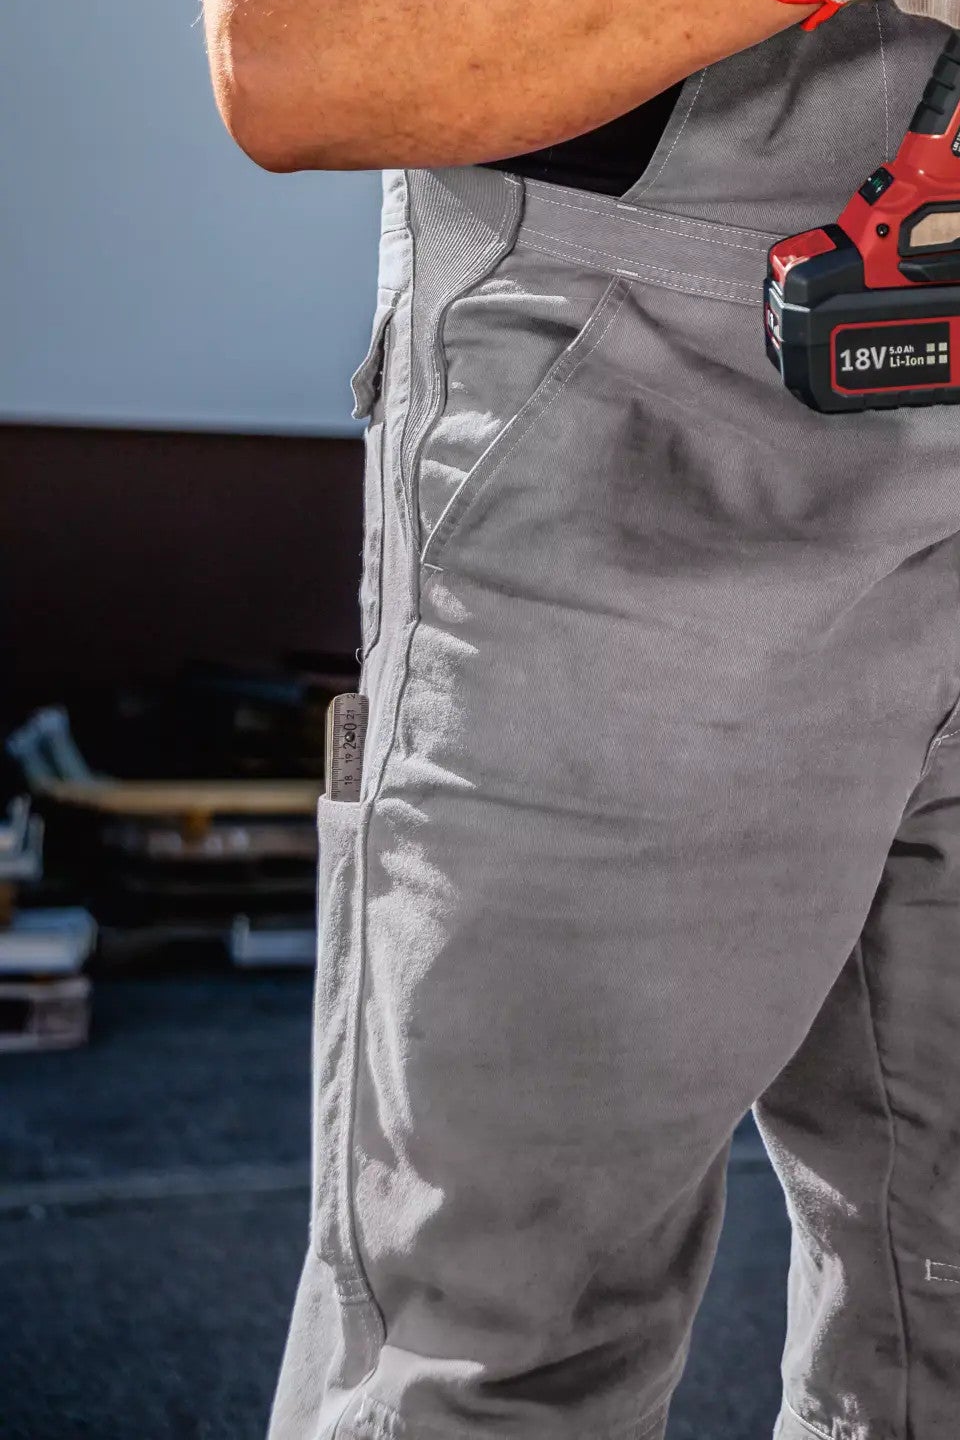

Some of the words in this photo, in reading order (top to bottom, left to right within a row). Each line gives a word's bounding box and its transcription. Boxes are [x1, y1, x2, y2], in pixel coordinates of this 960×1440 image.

[889, 346, 902, 354] 5.0
[903, 345, 914, 353] Ah
[840, 346, 887, 371] 18V
[890, 355, 924, 367] Li-Ion
[347, 709, 354, 719] 21
[345, 754, 353, 763] 19
[345, 775, 353, 785] 18
